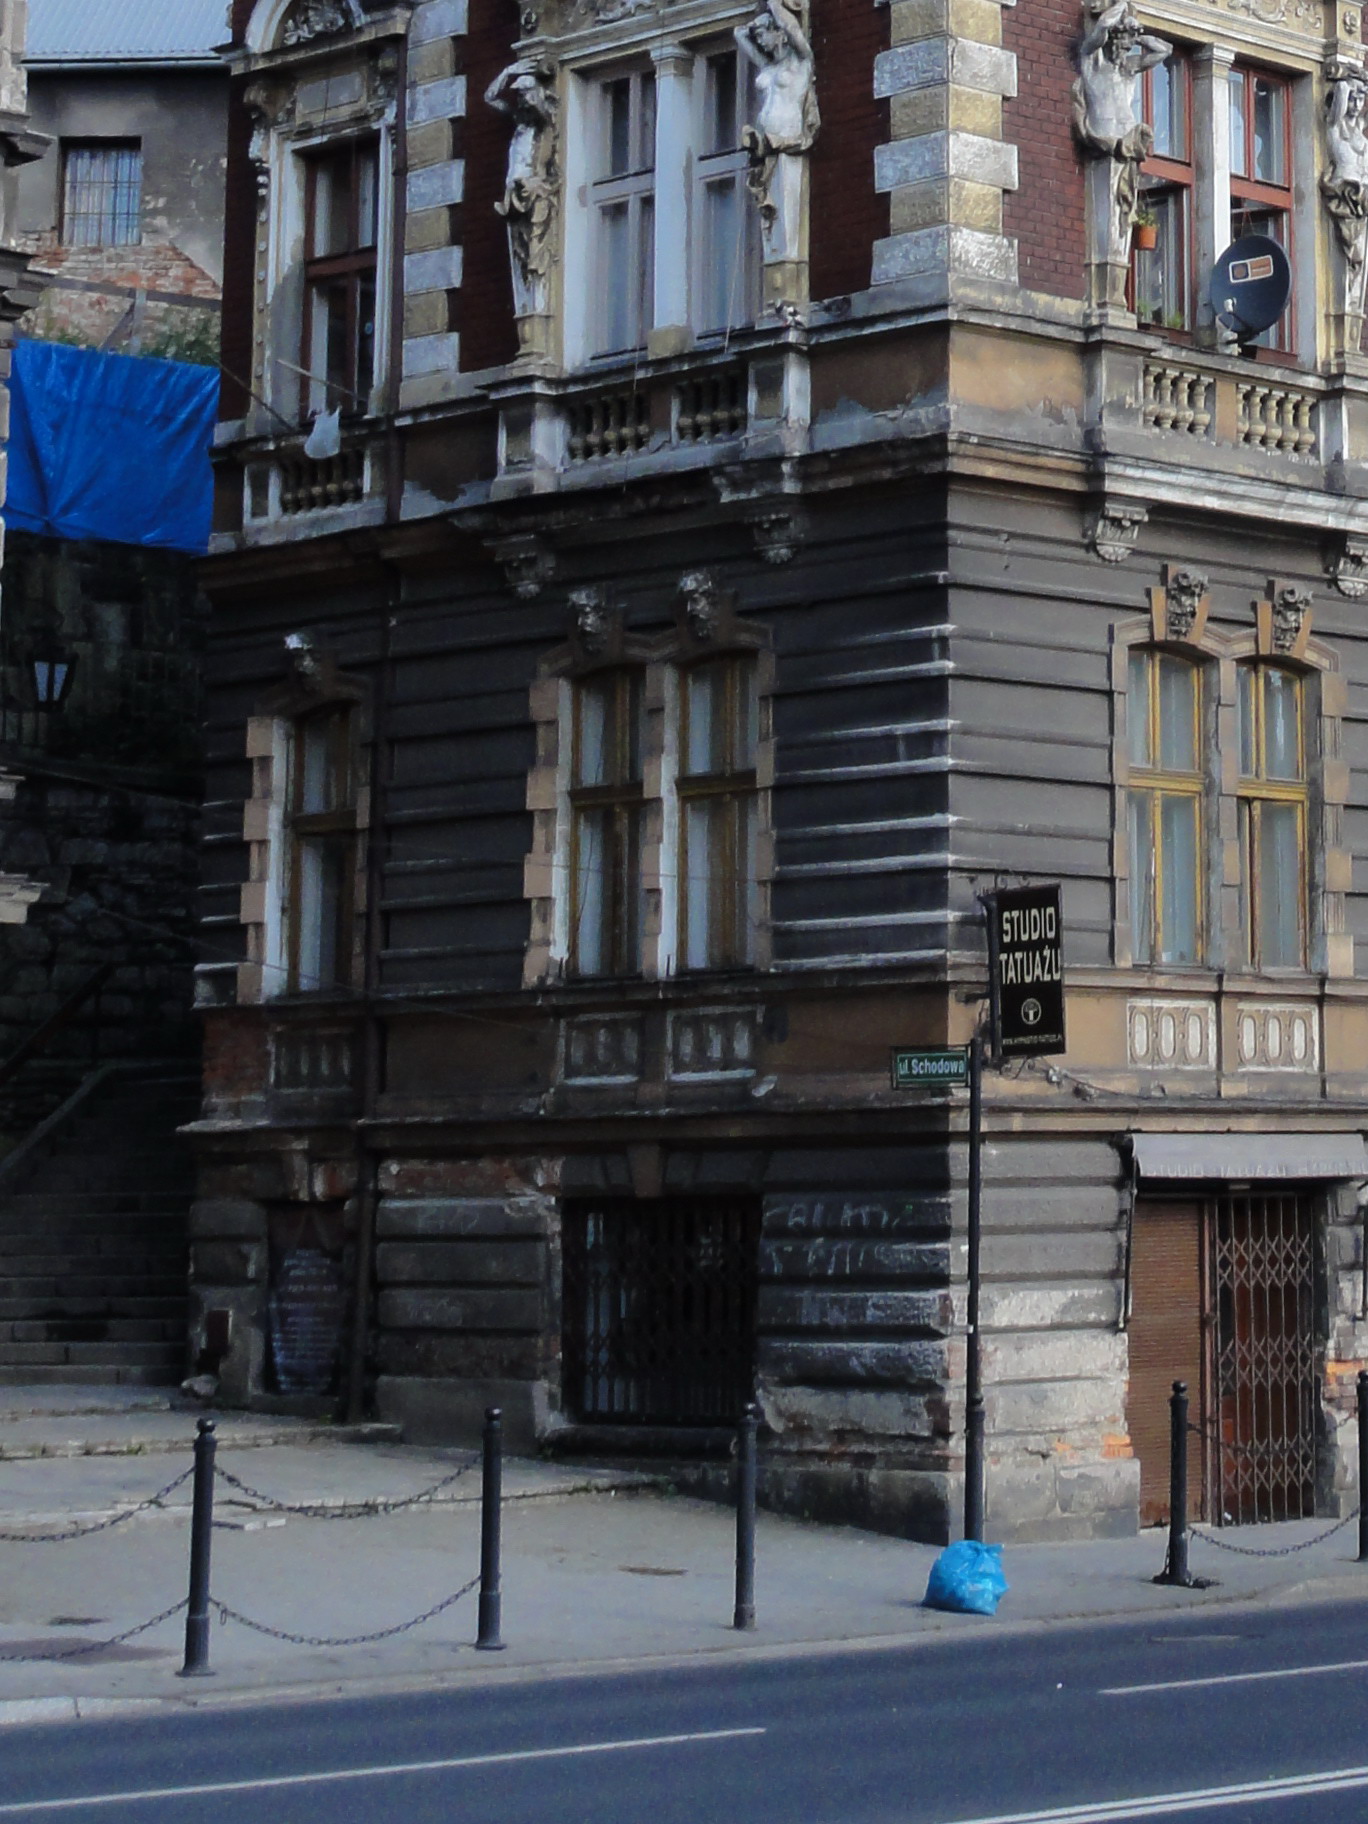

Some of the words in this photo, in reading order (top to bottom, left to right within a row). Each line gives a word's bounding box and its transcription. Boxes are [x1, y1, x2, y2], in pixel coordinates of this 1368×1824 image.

[1002, 906, 1056, 943] STUDIO
[999, 945, 1061, 984] TATUAŻU
[911, 1057, 965, 1075] Schodowa
